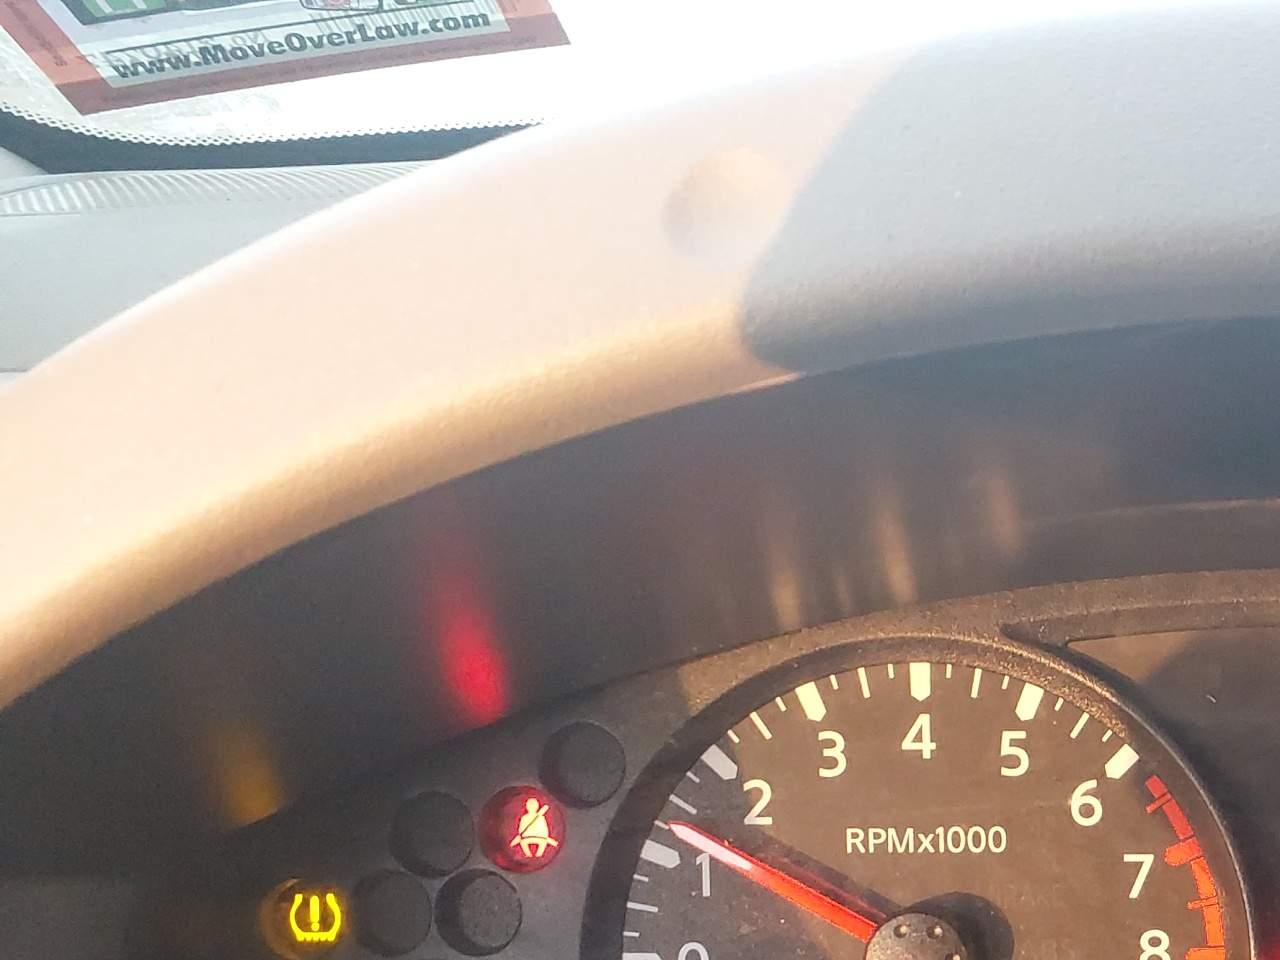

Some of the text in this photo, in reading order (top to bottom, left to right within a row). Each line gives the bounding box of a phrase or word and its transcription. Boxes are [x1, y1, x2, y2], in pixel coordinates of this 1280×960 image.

[112, 12, 490, 79] www.MoveOverLaw.com
[818, 731, 846, 777] 3
[902, 714, 936, 759] 4
[1001, 731, 1029, 776] 5
[744, 779, 772, 825] 2
[1069, 780, 1102, 826] 6
[847, 826, 1006, 853] RPMx1000
[696, 852, 710, 897] 1
[1124, 854, 1154, 898] 7
